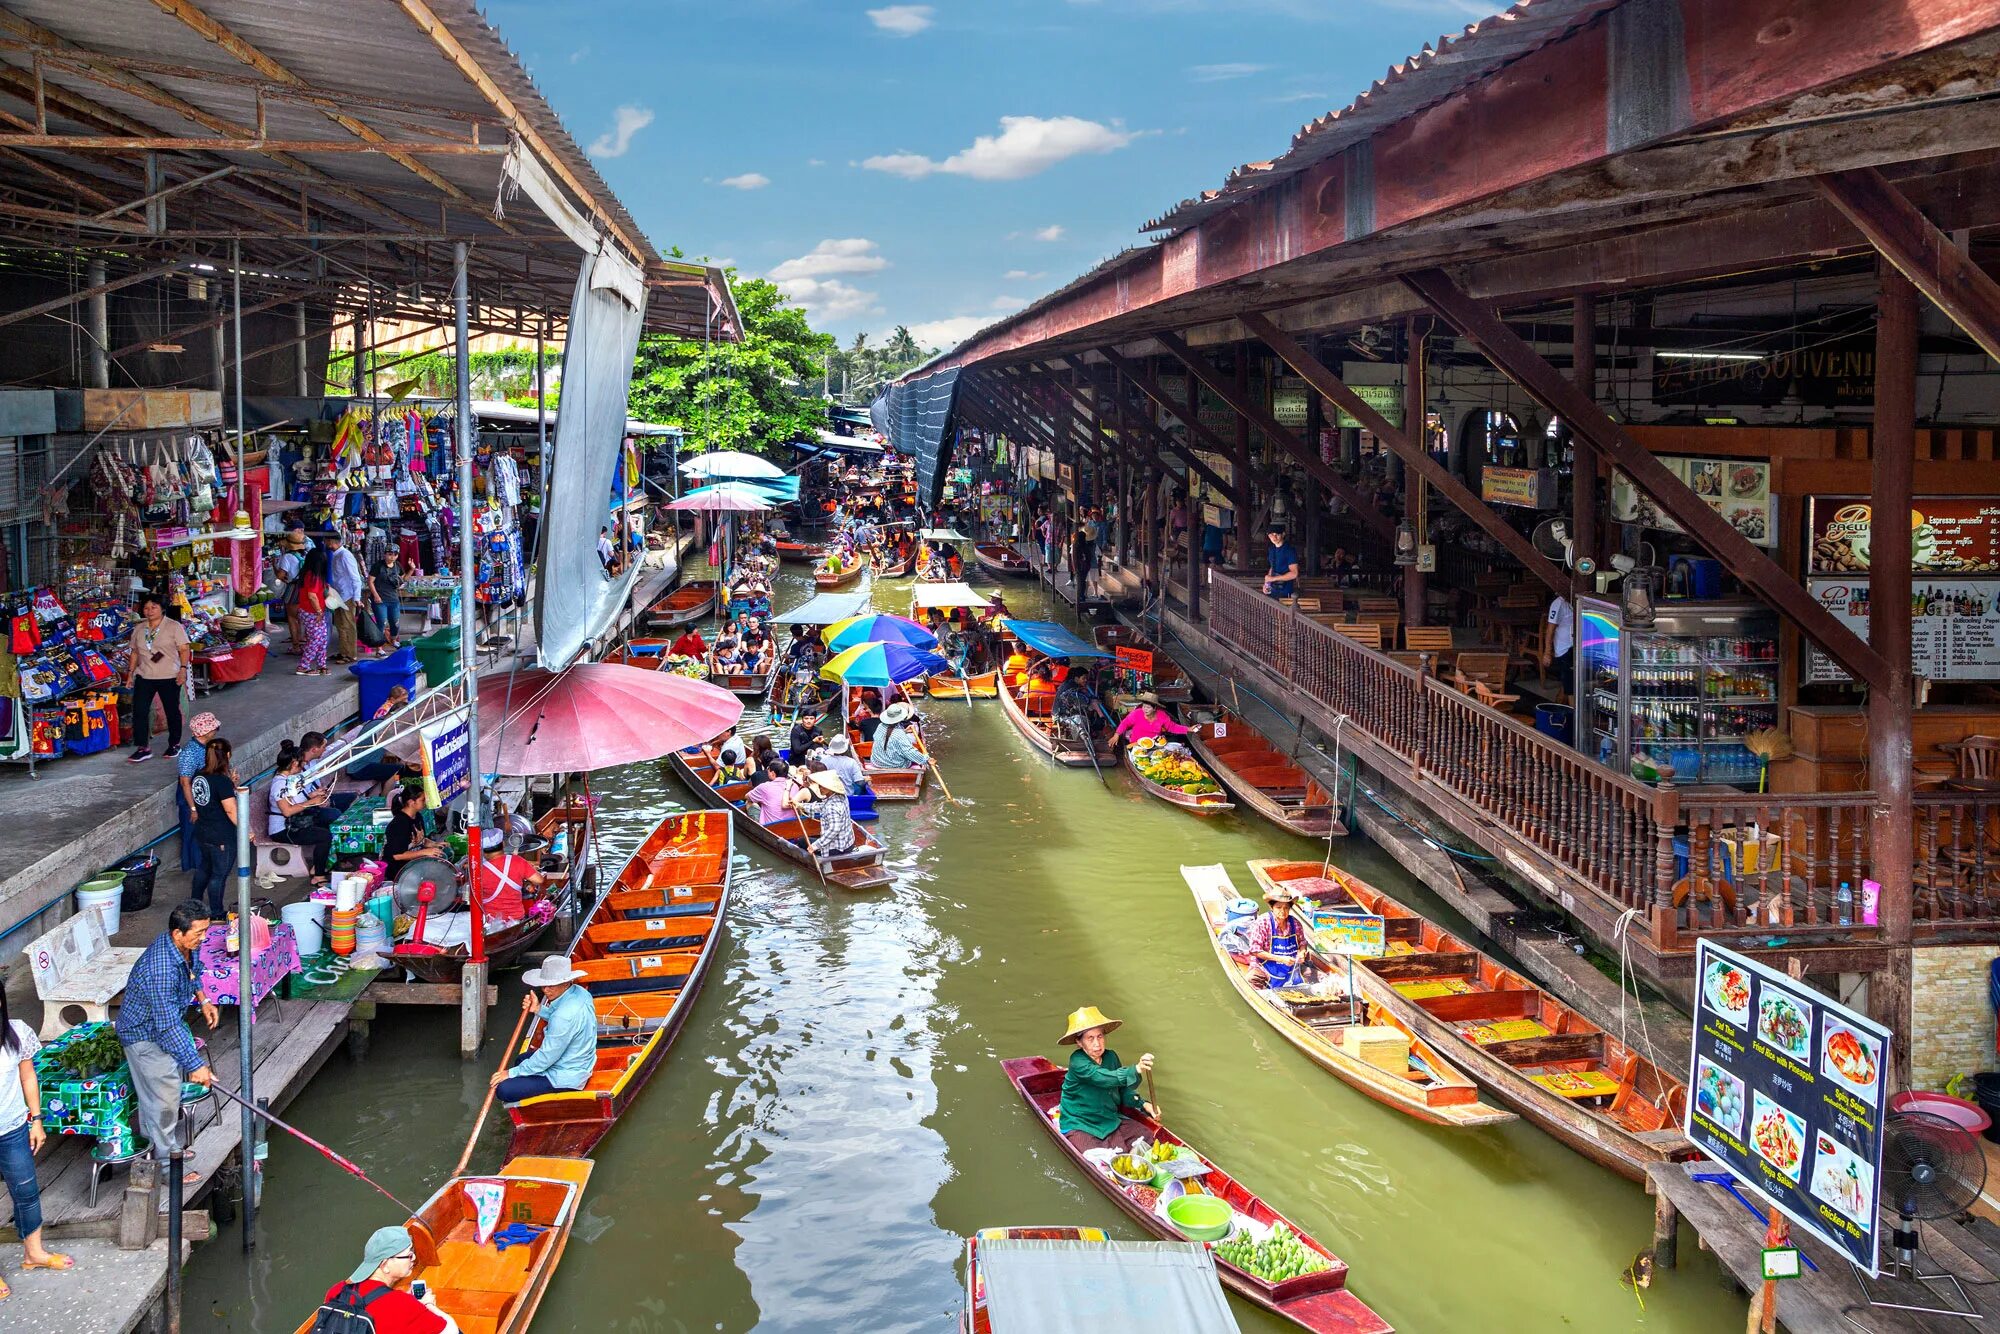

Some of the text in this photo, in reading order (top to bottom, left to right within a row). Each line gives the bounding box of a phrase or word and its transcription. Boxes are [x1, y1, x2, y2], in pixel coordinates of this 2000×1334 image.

[1756, 350, 1874, 379] SOUVENI
[1828, 523, 1868, 531] PAEW
[1929, 515, 1956, 526] Espresso
[1715, 1018, 1735, 1037] Pad Thai
[1752, 1040, 1815, 1084] Fried Rice with Pineapple
[1835, 1088, 1849, 1106] Spicy
[1849, 1098, 1866, 1116] Soup
[1708, 1122, 1719, 1137] Soup
[1719, 1131, 1729, 1143] with
[1760, 1159, 1776, 1179] Papaya
[512, 1202, 532, 1220] 15
[1819, 1204, 1845, 1228] Chicken
[1846, 1221, 1861, 1239] Rice
